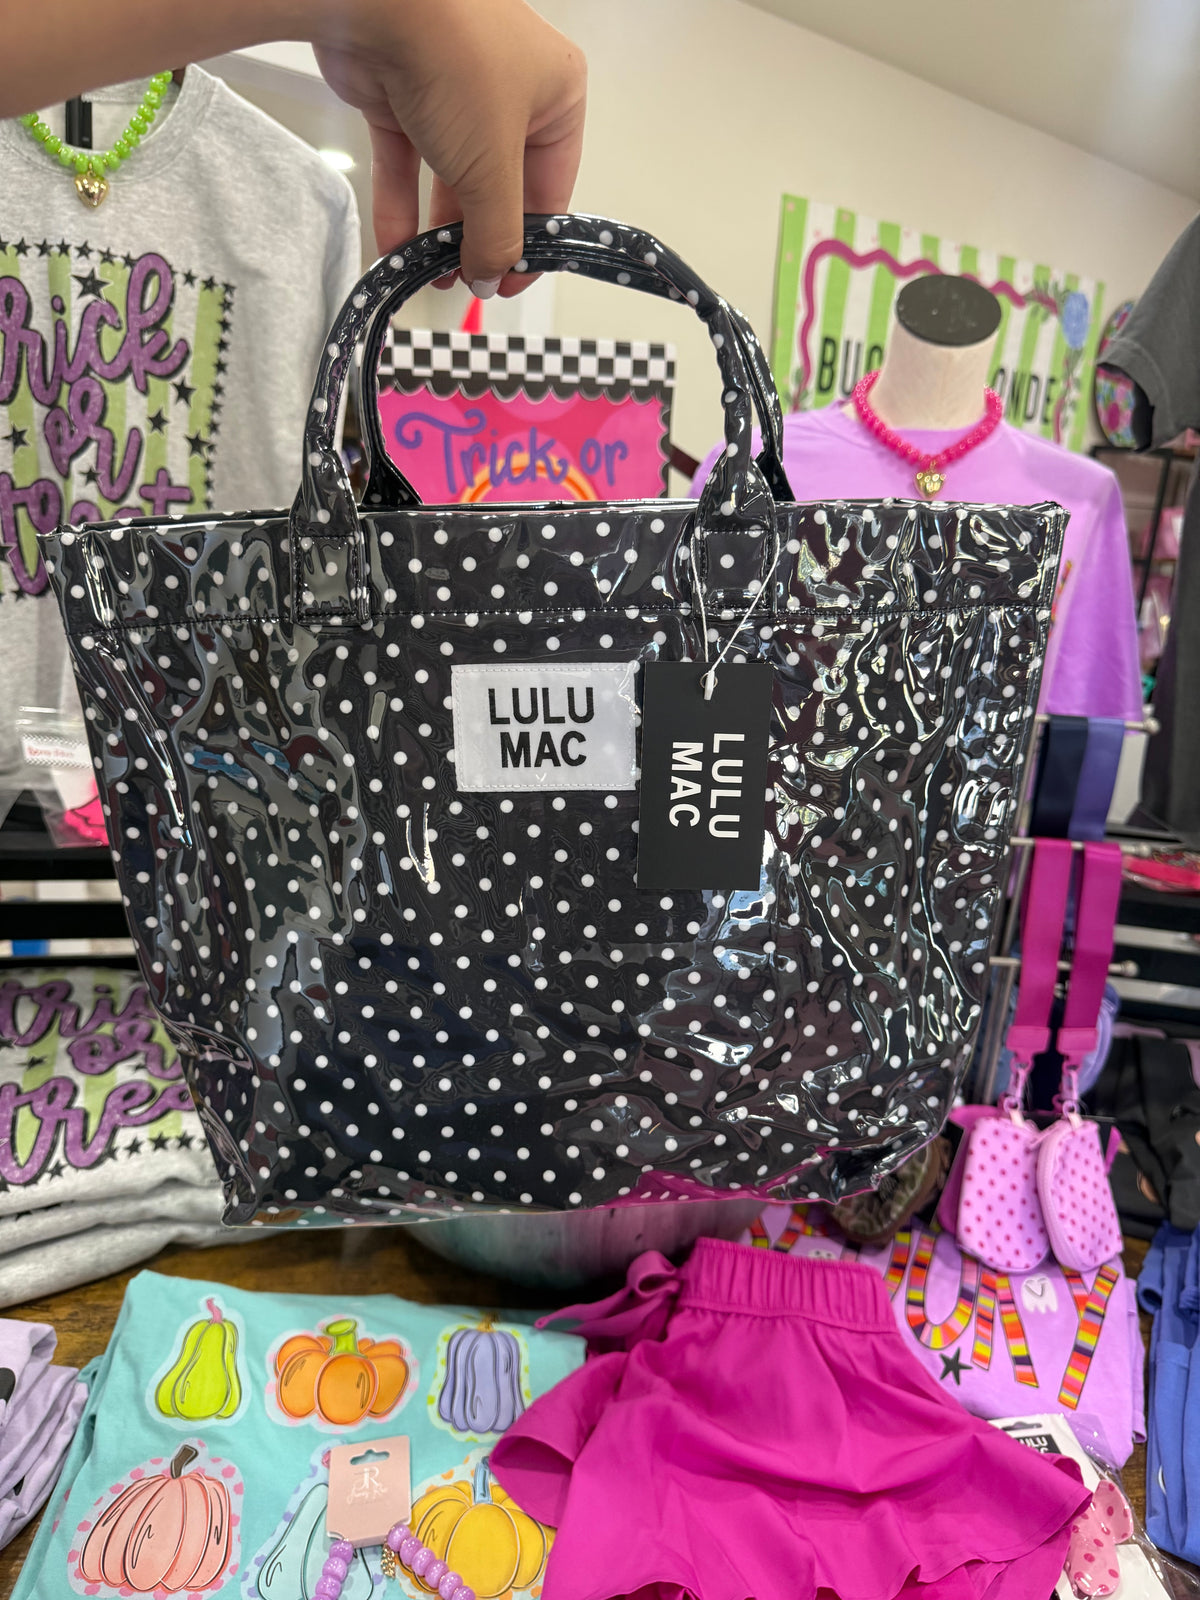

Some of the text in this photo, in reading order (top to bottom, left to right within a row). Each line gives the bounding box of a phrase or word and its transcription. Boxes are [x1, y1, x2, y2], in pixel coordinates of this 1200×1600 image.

[0, 253, 190, 406] rick
[44, 376, 142, 503] or
[395, 408, 628, 494] Trick or
[488, 687, 594, 725] LULU
[500, 731, 587, 768] MAC
[669, 742, 704, 827] MAC
[708, 733, 745, 838] LULU
